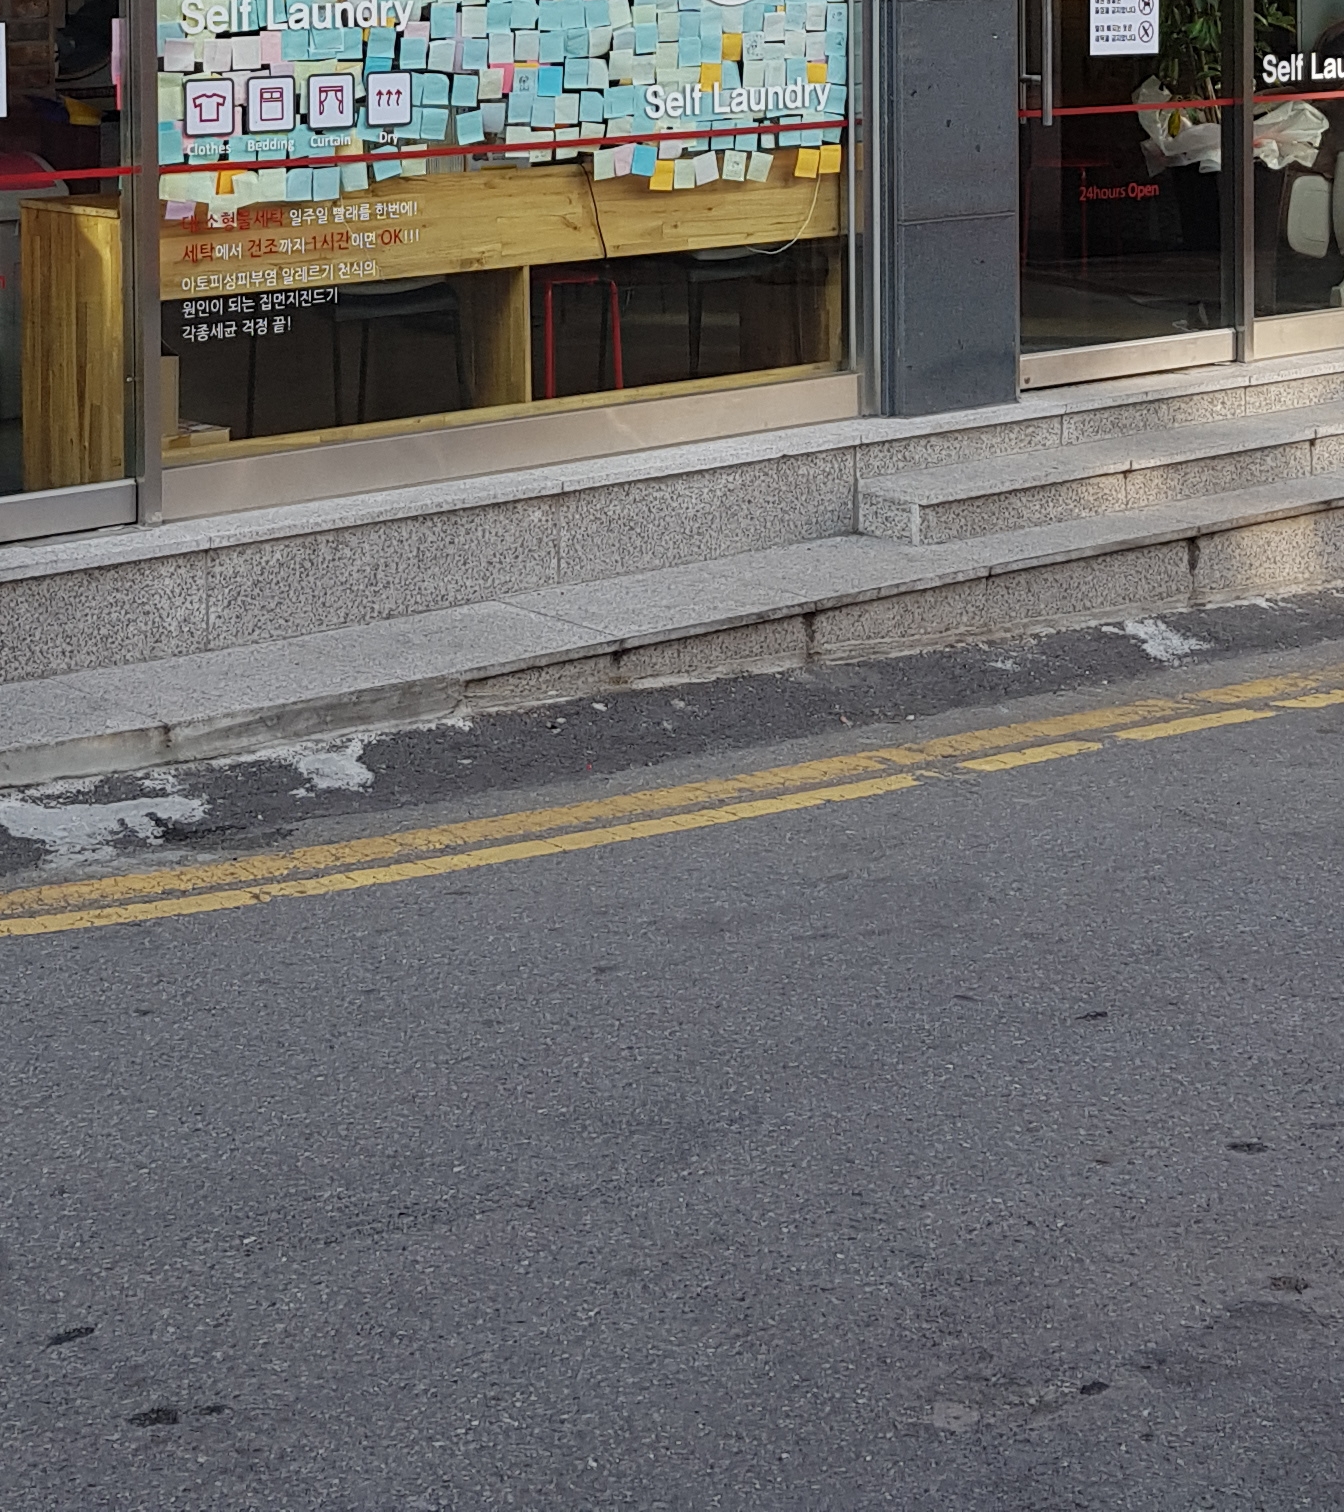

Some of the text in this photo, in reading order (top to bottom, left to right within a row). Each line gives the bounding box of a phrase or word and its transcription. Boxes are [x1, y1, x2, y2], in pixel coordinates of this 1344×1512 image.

[1262, 53, 1305, 84] Self
[645, 76, 832, 119] Self Laundry
[187, 142, 232, 156] Clothes
[247, 137, 295, 153] Bedding
[310, 133, 352, 148] Curtain
[378, 131, 399, 146] Dry
[1127, 182, 1160, 201] Open
[289, 200, 418, 226] 일주일 빨래를 한번에!
[182, 228, 420, 264] 세탁에서 건조까지 1시간이면 OK!!!
[181, 259, 377, 294] 아토피성피부염 알레르기 천식의
[181, 286, 339, 319] 원인이 되는 집먼지진드기
[181, 315, 292, 343] 각종세균 걱정 끝!
